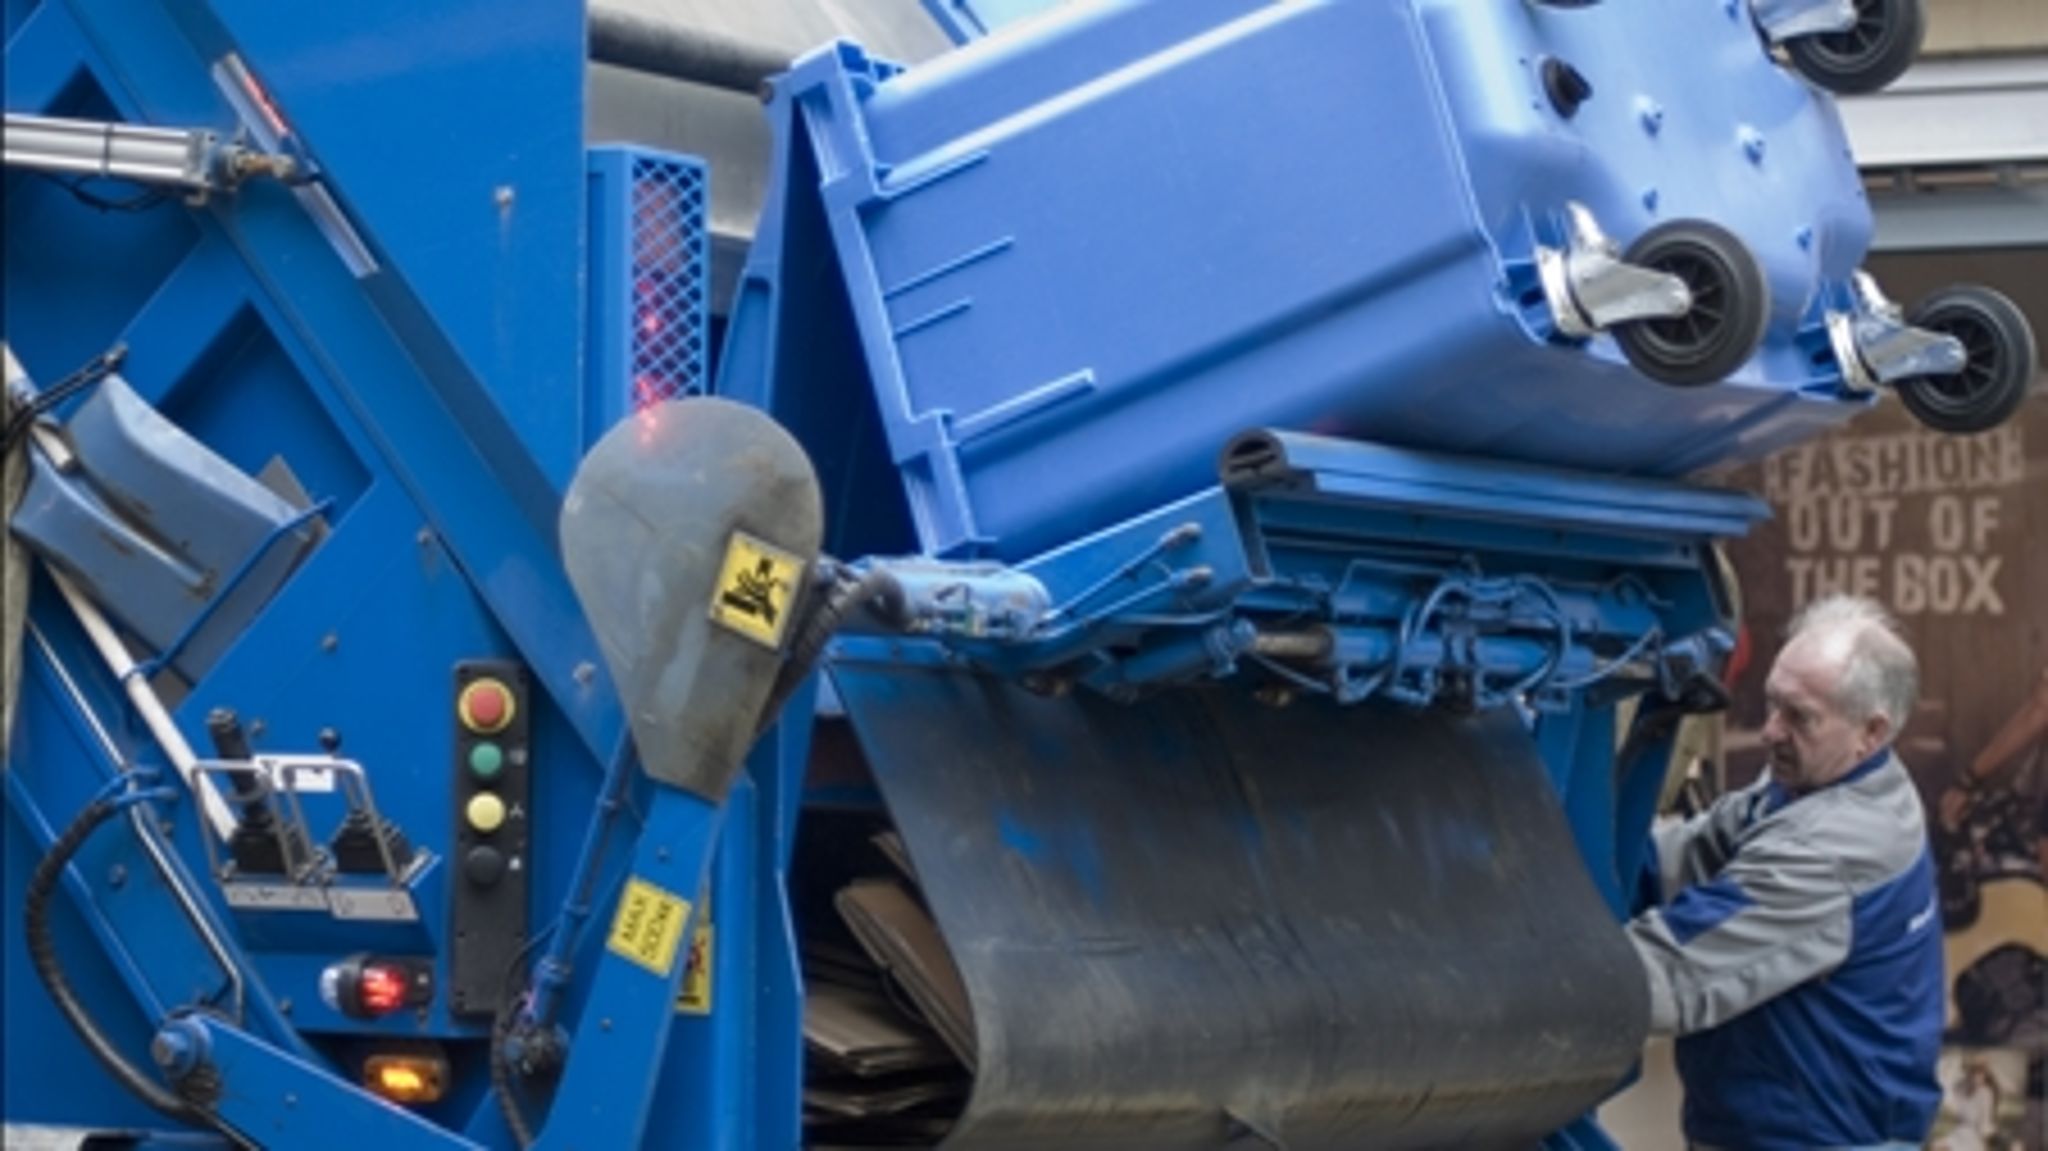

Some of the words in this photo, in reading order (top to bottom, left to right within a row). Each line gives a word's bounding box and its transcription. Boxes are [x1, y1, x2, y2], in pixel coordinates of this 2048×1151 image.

[1778, 437, 1996, 491] FASHION
[1788, 497, 1897, 551] OUT
[1929, 496, 2001, 551] OF
[1786, 556, 1880, 611] THE
[1893, 554, 2004, 614] BOX
